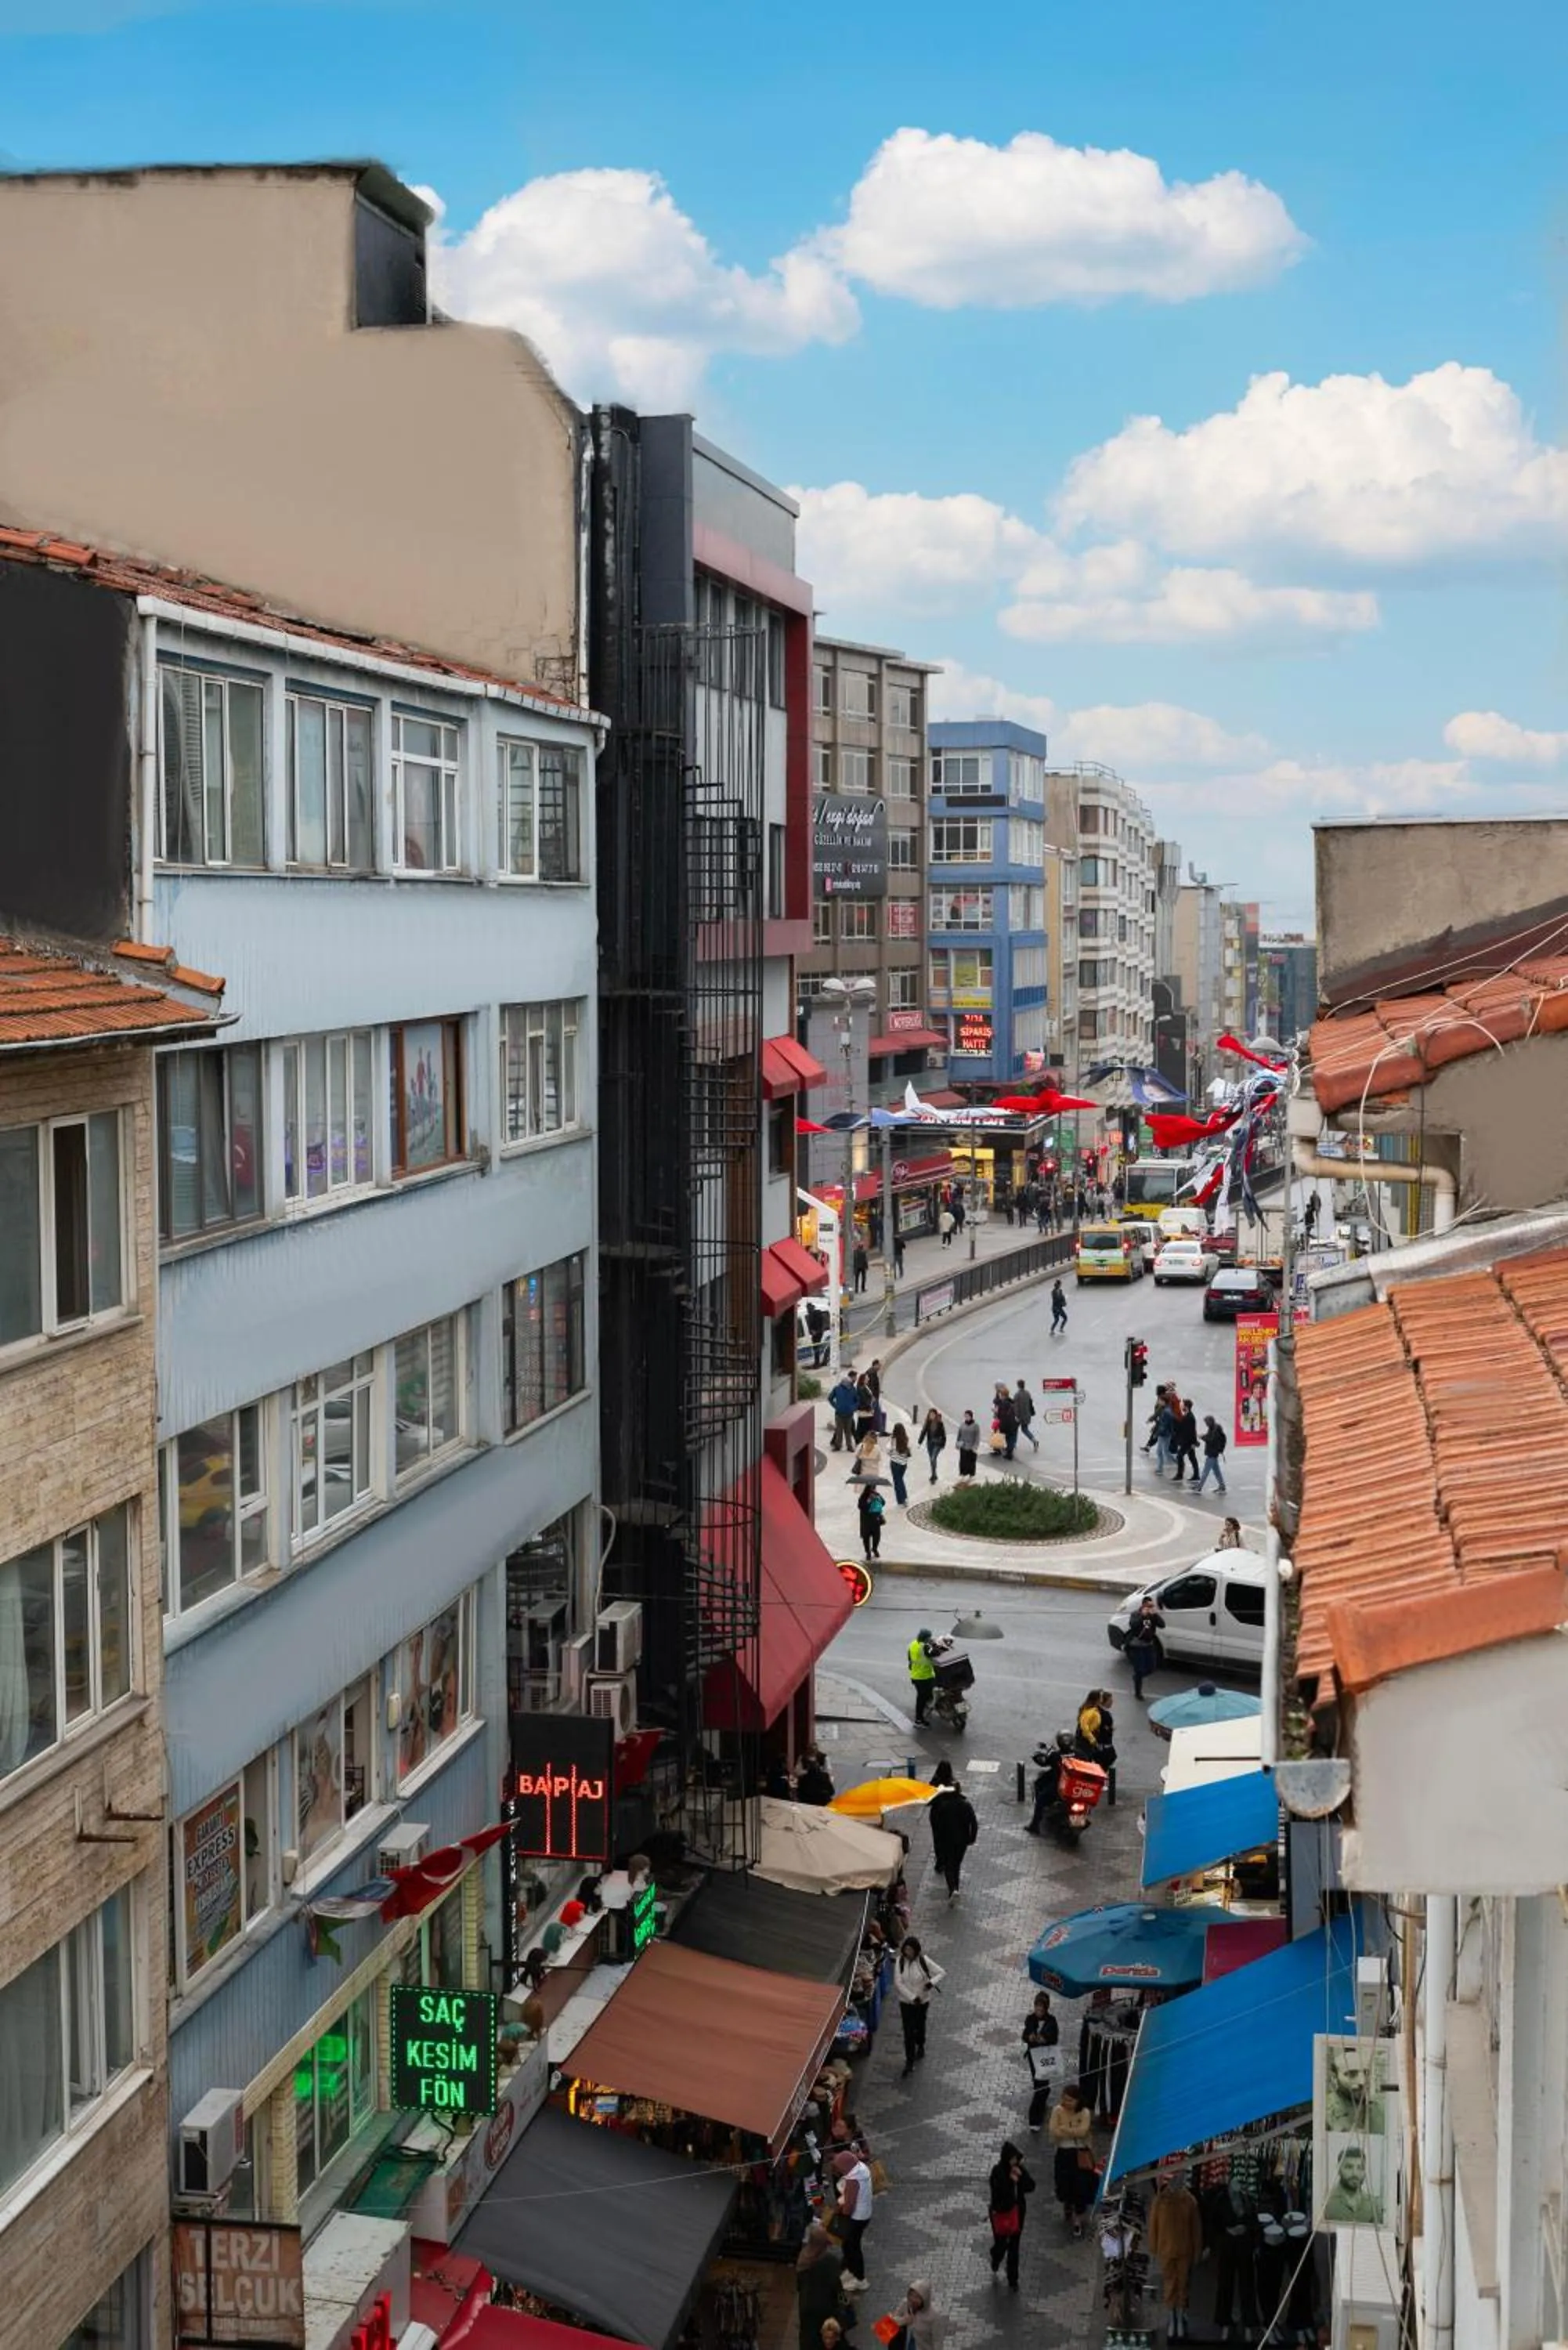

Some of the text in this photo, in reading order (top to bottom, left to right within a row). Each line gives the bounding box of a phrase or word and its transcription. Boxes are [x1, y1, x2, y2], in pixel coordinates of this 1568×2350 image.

[186, 1827, 236, 1881] EXPRESS
[419, 1995, 465, 2033] SAÇ
[406, 2037, 477, 2072] KESİM
[421, 2073, 464, 2108] FÖN
